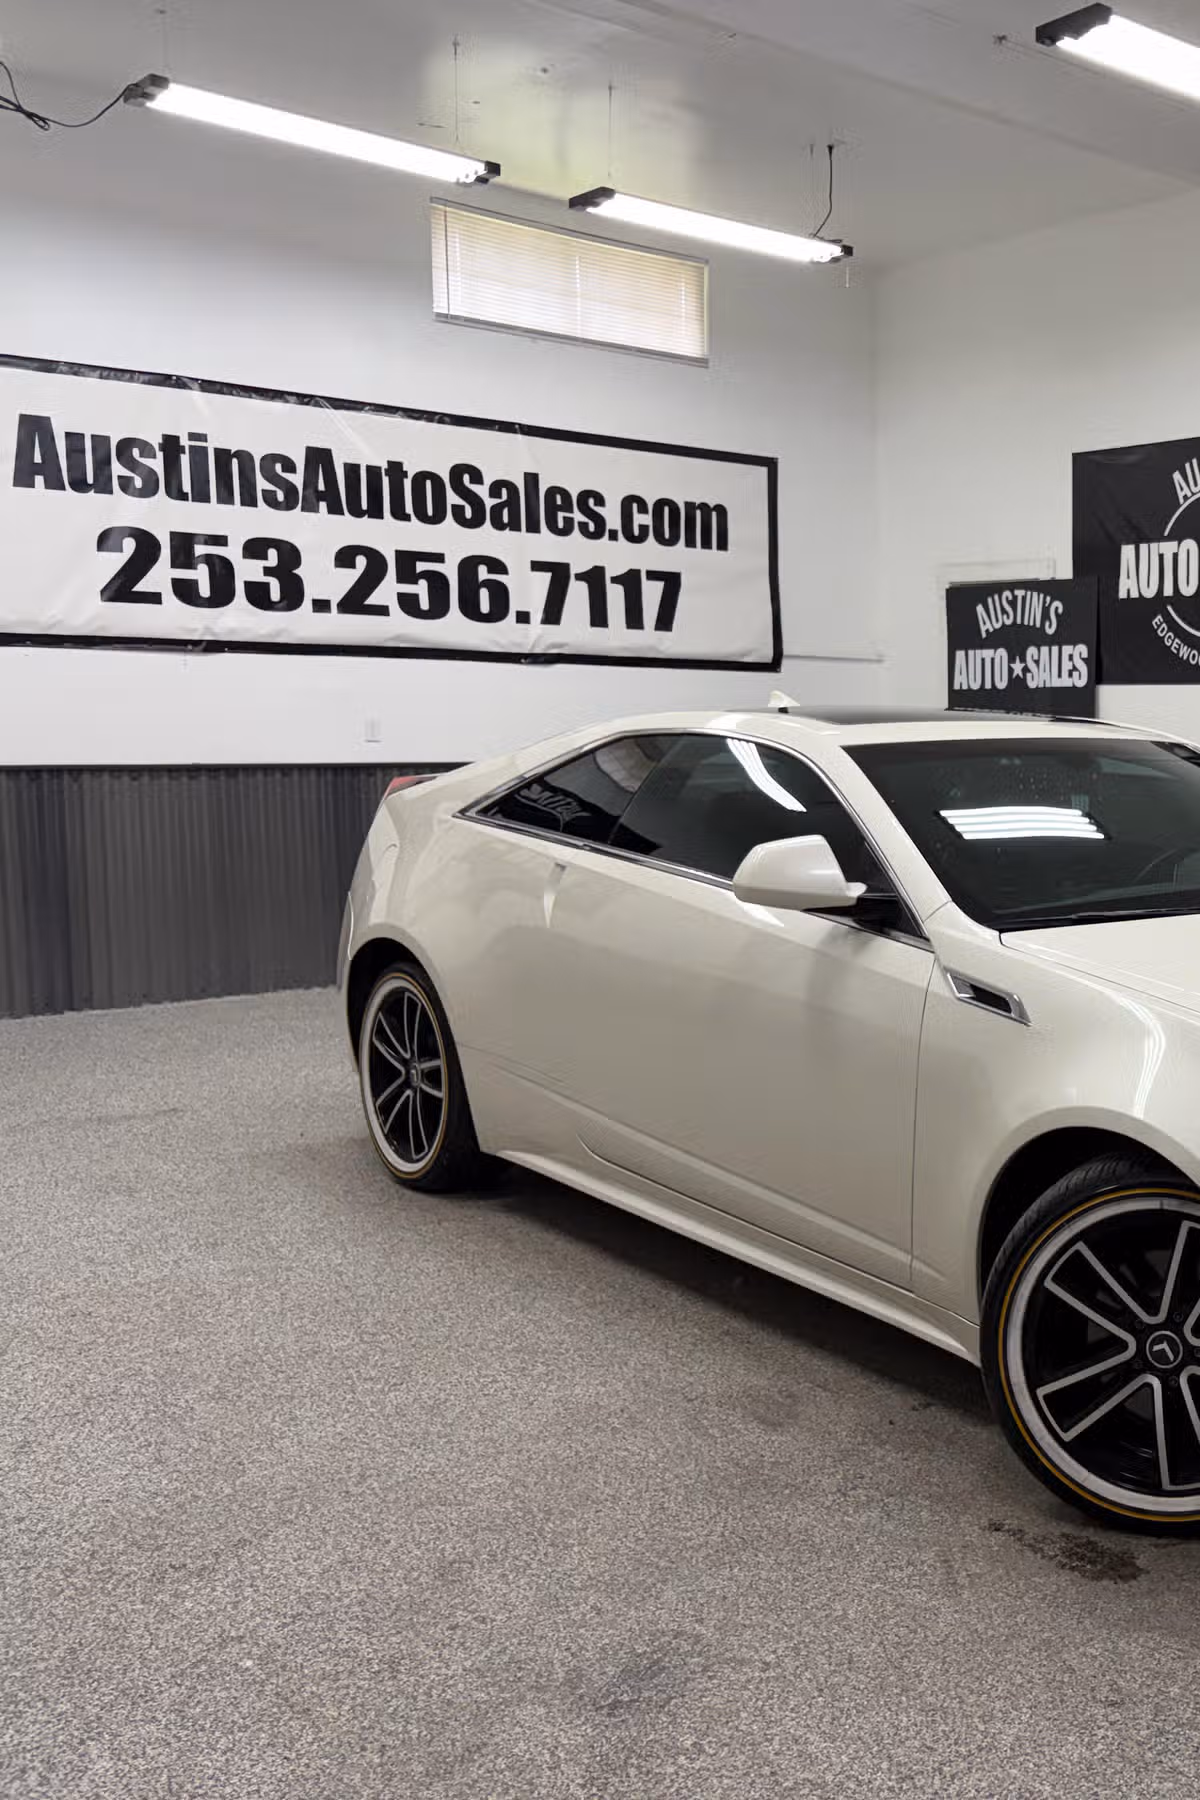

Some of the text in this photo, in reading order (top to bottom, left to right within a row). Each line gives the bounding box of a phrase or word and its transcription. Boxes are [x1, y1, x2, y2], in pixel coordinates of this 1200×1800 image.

[12, 413, 729, 552] AustinsAutoSales.com
[96, 525, 682, 633] 253.256.7117
[1118, 538, 1199, 600] AUTO
[975, 589, 1064, 639] AUSTIN'S
[953, 643, 1089, 691] AUTO SALES
